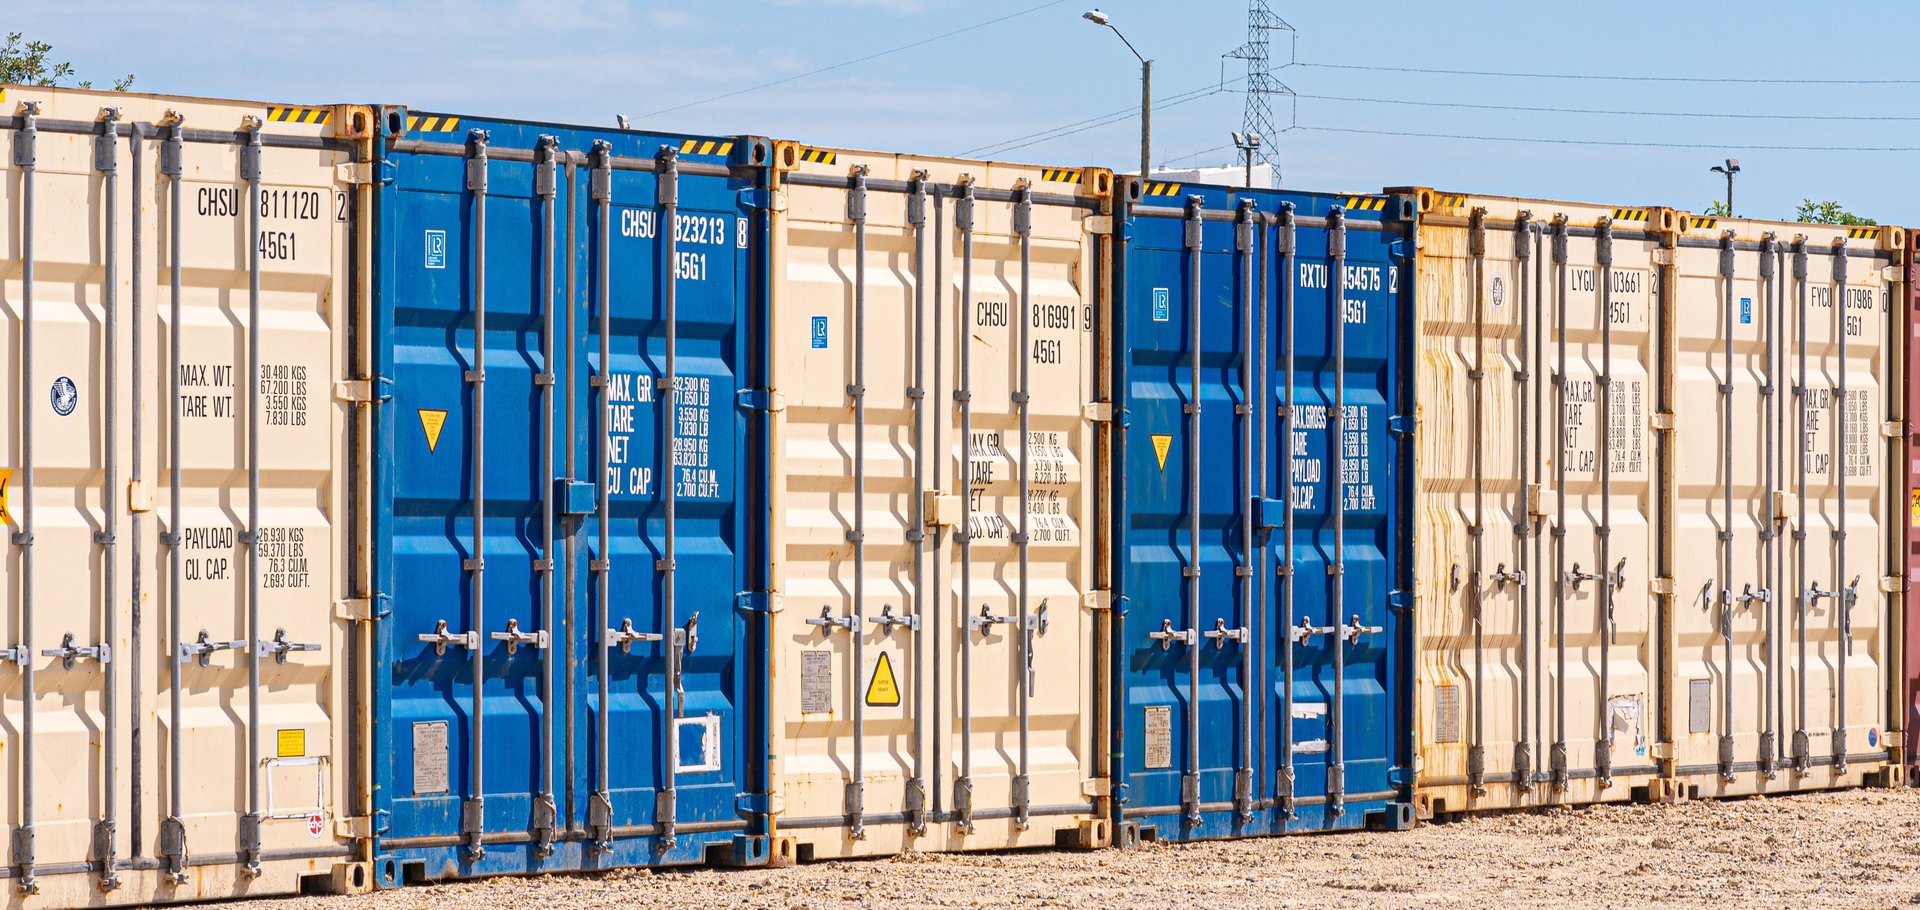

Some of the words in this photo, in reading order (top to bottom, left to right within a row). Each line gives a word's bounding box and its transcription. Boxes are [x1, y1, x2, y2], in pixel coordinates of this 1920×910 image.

[198, 188, 238, 217] CHSU
[261, 190, 318, 220] 811120
[338, 193, 346, 220] 2
[622, 209, 656, 238] CHSU
[675, 215, 724, 245] 823213
[738, 220, 746, 247] 8
[260, 231, 295, 260] 45G1
[675, 252, 706, 280] 45G1
[1300, 263, 1327, 288] RXTU
[1343, 266, 1380, 291] 454575
[1390, 268, 1396, 292] 2
[1572, 270, 1594, 291] LYGU
[1652, 274, 1657, 294] 2
[1812, 287, 1832, 307] FYCU
[1847, 289, 1872, 309] 07986
[977, 302, 1007, 326] CHSU
[1033, 304, 1075, 329] 816991
[1084, 306, 1091, 330] 9
[1610, 302, 1629, 323] 45G1
[1847, 316, 1861, 336] 5G1
[1033, 340, 1060, 364] 45G1
[180, 365, 209, 386] MAX.
[213, 365, 234, 387] WT.
[261, 365, 288, 379] 30.480
[292, 366, 306, 380] KGS
[261, 380, 288, 394] 67.200
[292, 381, 306, 395] LBS
[608, 374, 634, 402] MAX.
[637, 375, 655, 402] GR.
[700, 378, 709, 392] KG
[182, 396, 207, 417] TARE
[213, 396, 234, 418] WT.
[266, 396, 288, 410] 3.550
[292, 396, 306, 410] KGS
[700, 391, 709, 406] LB
[266, 411, 288, 425] 7.830
[291, 412, 306, 425] LBS
[608, 405, 634, 432] TARE
[700, 408, 708, 422] KG
[1361, 406, 1368, 418] KG
[1565, 404, 1582, 425] TARE
[1806, 411, 1819, 430] ARE
[699, 422, 708, 436] LB
[1361, 418, 1368, 430] LB
[699, 438, 708, 452] KG
[1028, 433, 1044, 445] 2.500
[1049, 433, 1057, 445] KG
[1361, 432, 1368, 444] KG
[1565, 427, 1577, 448] NET
[1806, 432, 1815, 452] ET
[608, 436, 629, 464] NET
[699, 453, 708, 467] LB
[1361, 445, 1368, 457] LB
[1291, 459, 1320, 483] PAYLOAD
[1362, 459, 1368, 471] KG
[1580, 451, 1594, 472] CAP.
[608, 467, 623, 494] CU.
[630, 467, 654, 494] CAP.
[970, 461, 993, 484] TARE
[1055, 473, 1067, 484] LBS
[1362, 472, 1368, 483] LB
[970, 488, 985, 512] ET
[1049, 490, 1059, 501] KG
[1028, 503, 1044, 514] 3.430
[1048, 503, 1060, 514] LBS
[185, 527, 233, 549] PAYLOAD
[258, 528, 285, 542] 26.930
[289, 528, 304, 542] KGS
[258, 543, 285, 557] 59.370
[289, 543, 303, 557] LBS
[185, 558, 201, 580] CU.
[206, 558, 229, 580] CAP.
[269, 558, 285, 572] 76.3
[263, 574, 285, 588] 2.693
